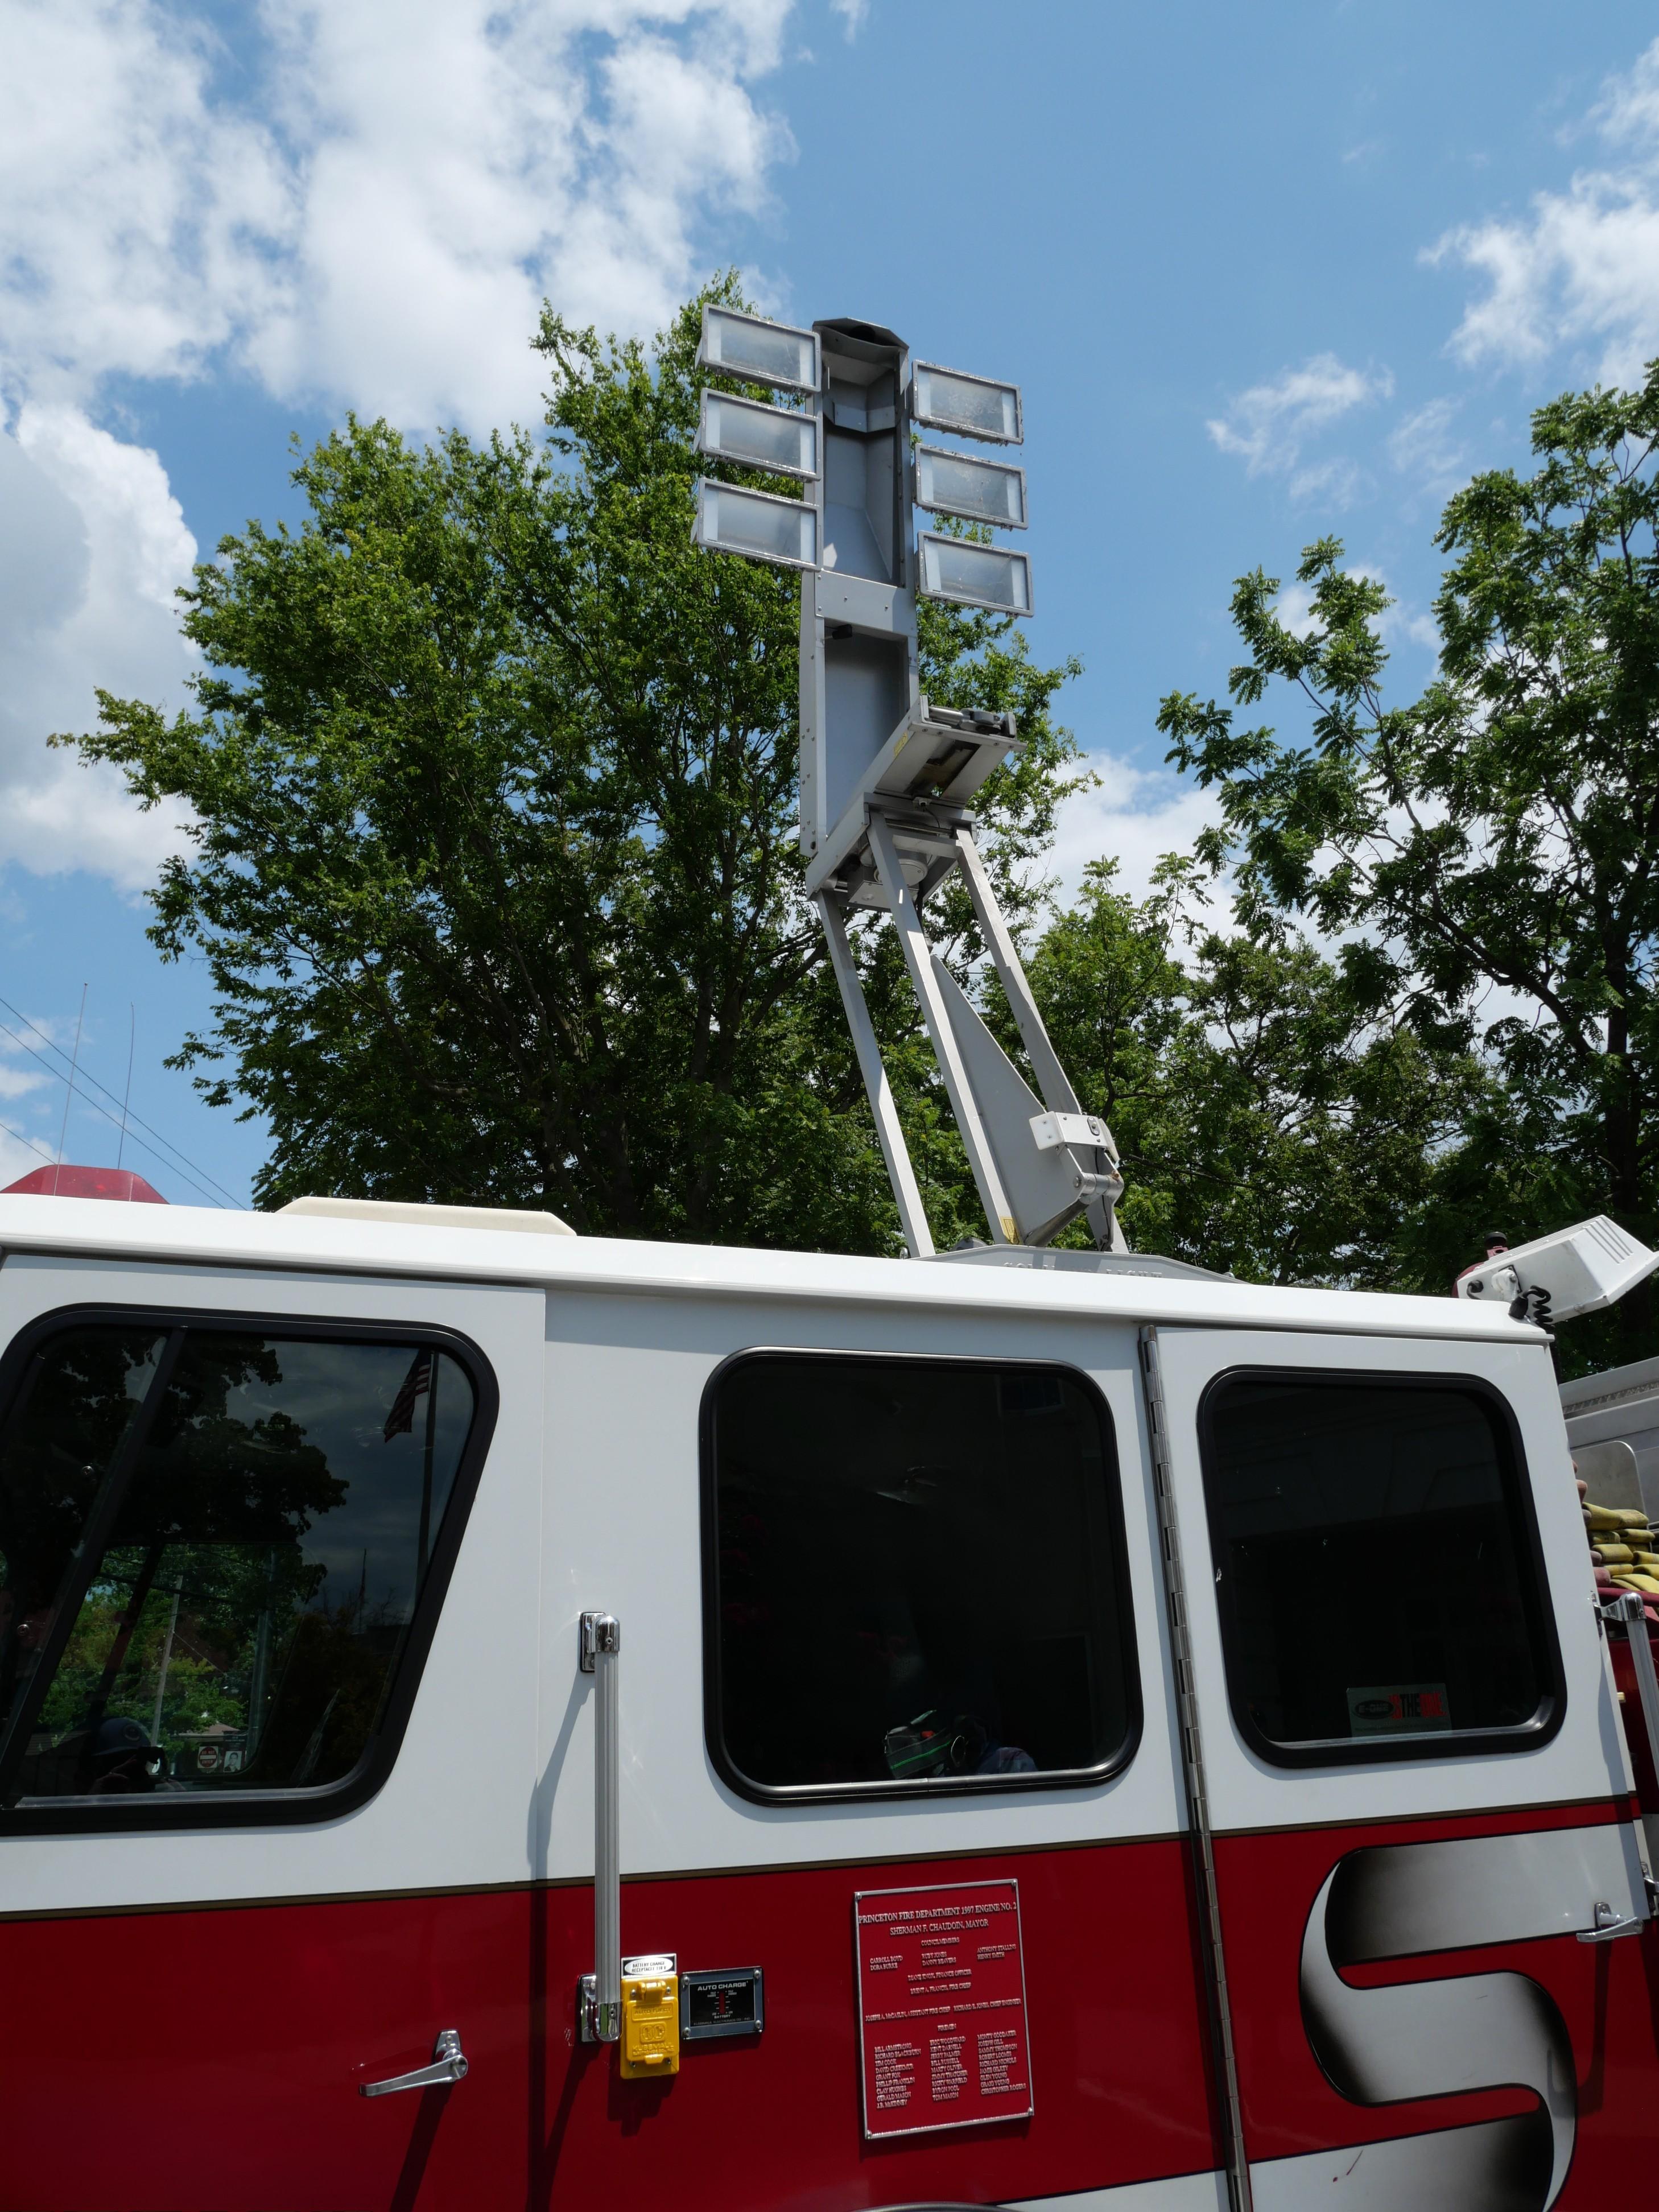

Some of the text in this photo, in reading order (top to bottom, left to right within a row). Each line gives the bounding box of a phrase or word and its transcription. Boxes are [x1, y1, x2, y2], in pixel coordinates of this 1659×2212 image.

[859, 1913, 897, 1924] PRINCETON
[899, 1911, 914, 1920] FIRE
[915, 1907, 960, 1918] DEPARTMENT
[975, 1904, 1000, 1913] ENGINE
[890, 1925, 921, 1935] SHERMAN
[965, 1918, 988, 1928] MAYOR
